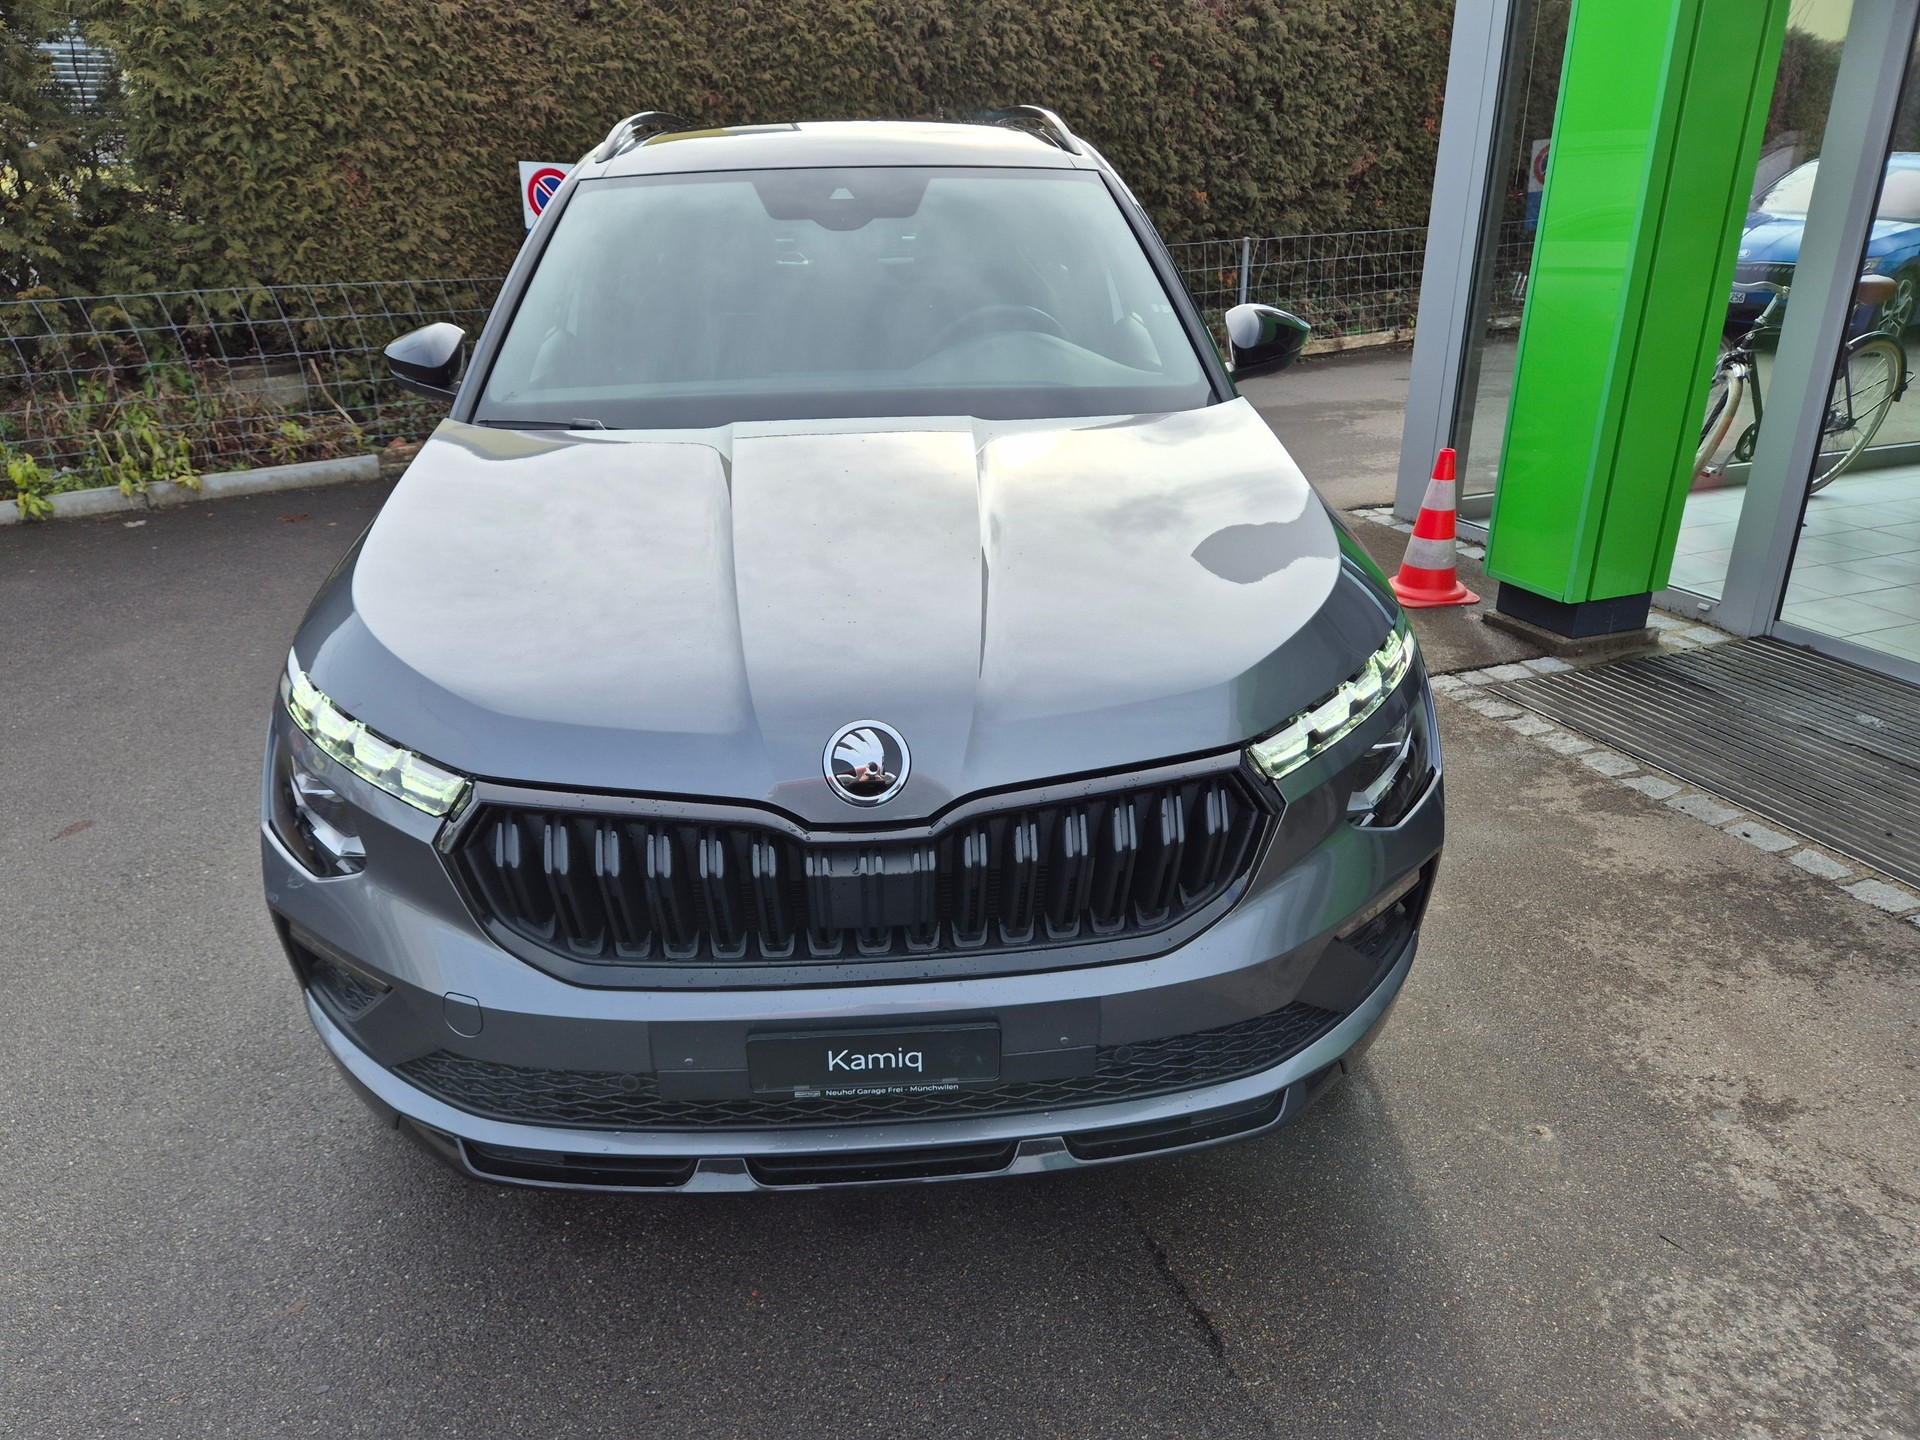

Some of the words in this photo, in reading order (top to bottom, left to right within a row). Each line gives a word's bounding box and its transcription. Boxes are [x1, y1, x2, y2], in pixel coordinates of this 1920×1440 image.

[828, 1047, 923, 1072] Kamiq
[825, 1088, 856, 1096] Neuhof
[857, 1086, 886, 1095] Garage
[910, 1083, 959, 1092] Münchwilen
